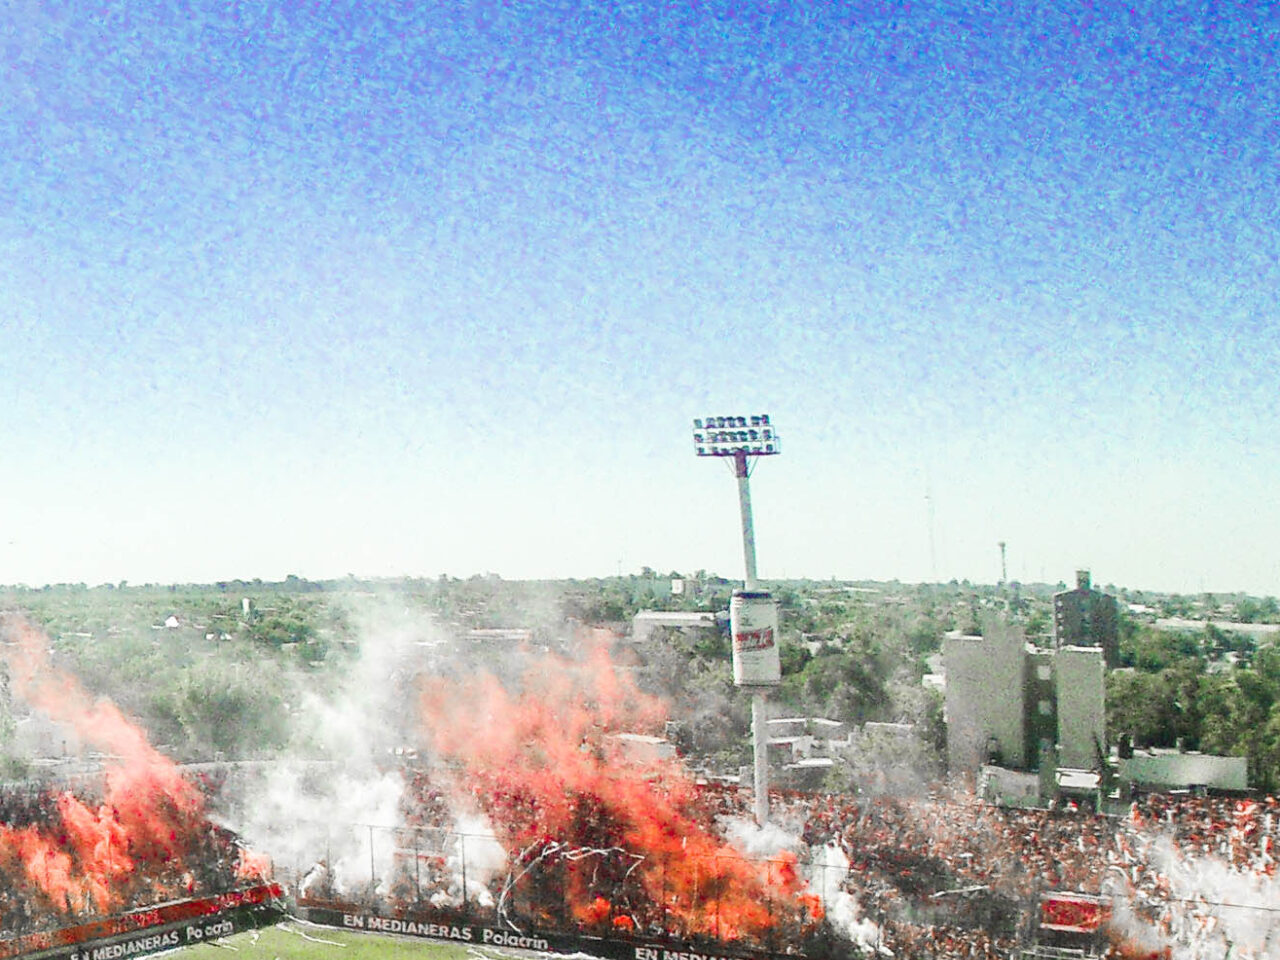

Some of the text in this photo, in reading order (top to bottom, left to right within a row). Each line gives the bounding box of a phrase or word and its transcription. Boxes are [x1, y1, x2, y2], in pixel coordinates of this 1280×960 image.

[186, 920, 233, 941] Poacrin
[343, 914, 548, 950] EN MEDIANERAS Polacrin
